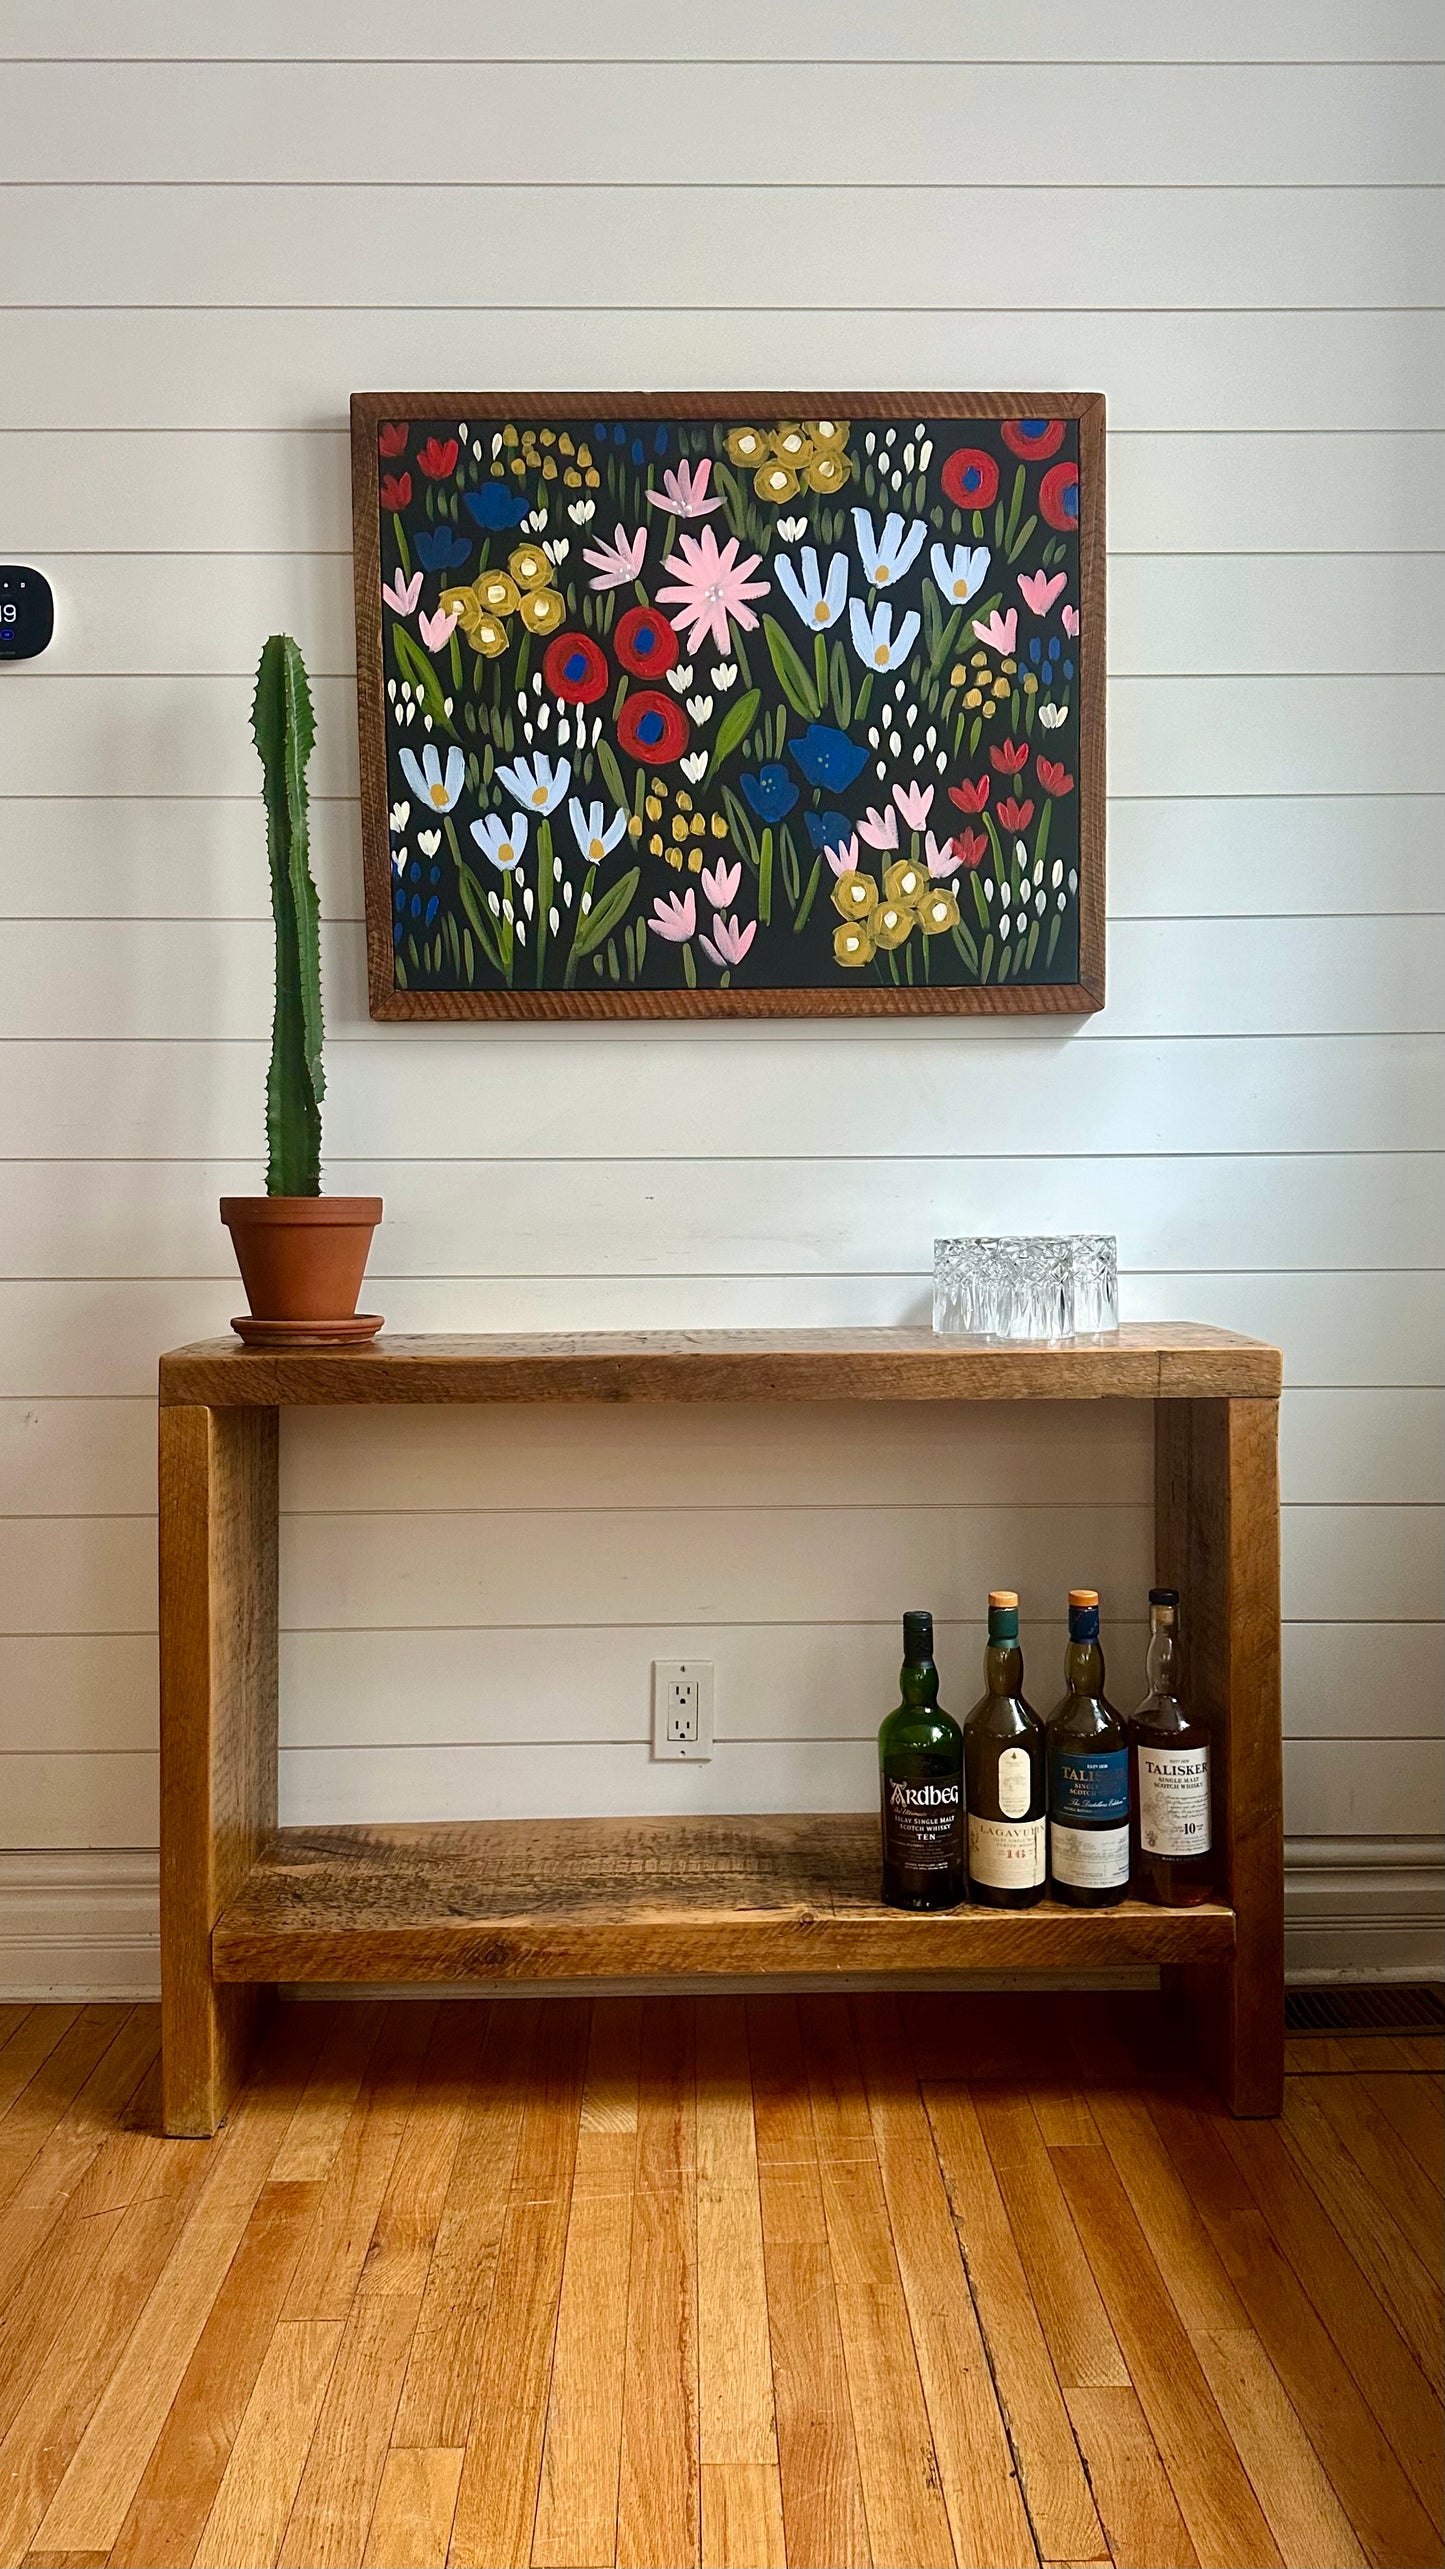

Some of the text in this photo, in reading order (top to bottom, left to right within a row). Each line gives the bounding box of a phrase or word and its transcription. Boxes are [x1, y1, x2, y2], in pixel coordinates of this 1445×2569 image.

[1145, 1761, 1208, 1776] TALISKER
[894, 1814, 956, 1825] ISLAY SINGLE MALT
[899, 1823, 952, 1832] SCOTCH WHISKY
[1184, 1822, 1196, 1835] 10
[916, 1833, 936, 1841] TEN
[1006, 1849, 1026, 1859] 16
